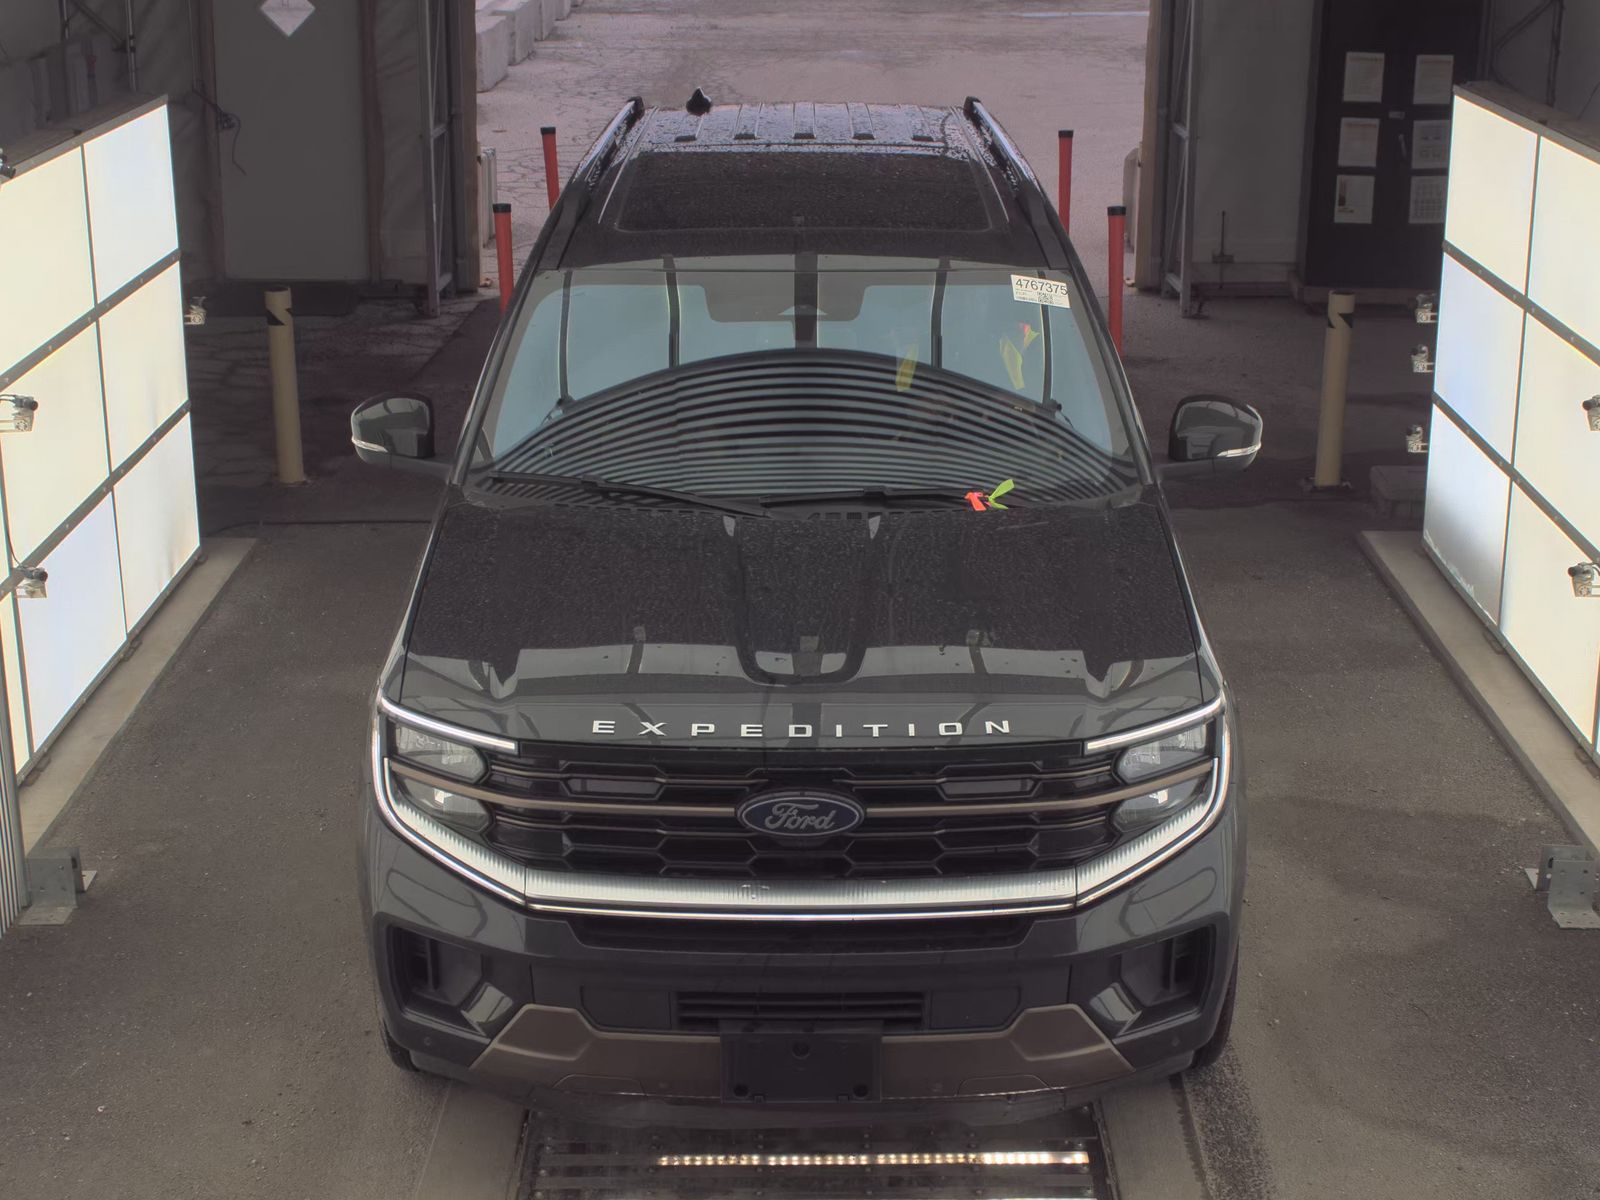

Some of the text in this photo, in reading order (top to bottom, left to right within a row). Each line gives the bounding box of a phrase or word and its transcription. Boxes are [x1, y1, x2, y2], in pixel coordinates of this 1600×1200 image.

[1015, 278, 1068, 296] 4767375
[592, 719, 1011, 738] EXPEDITION
[764, 802, 837, 830] Ford
